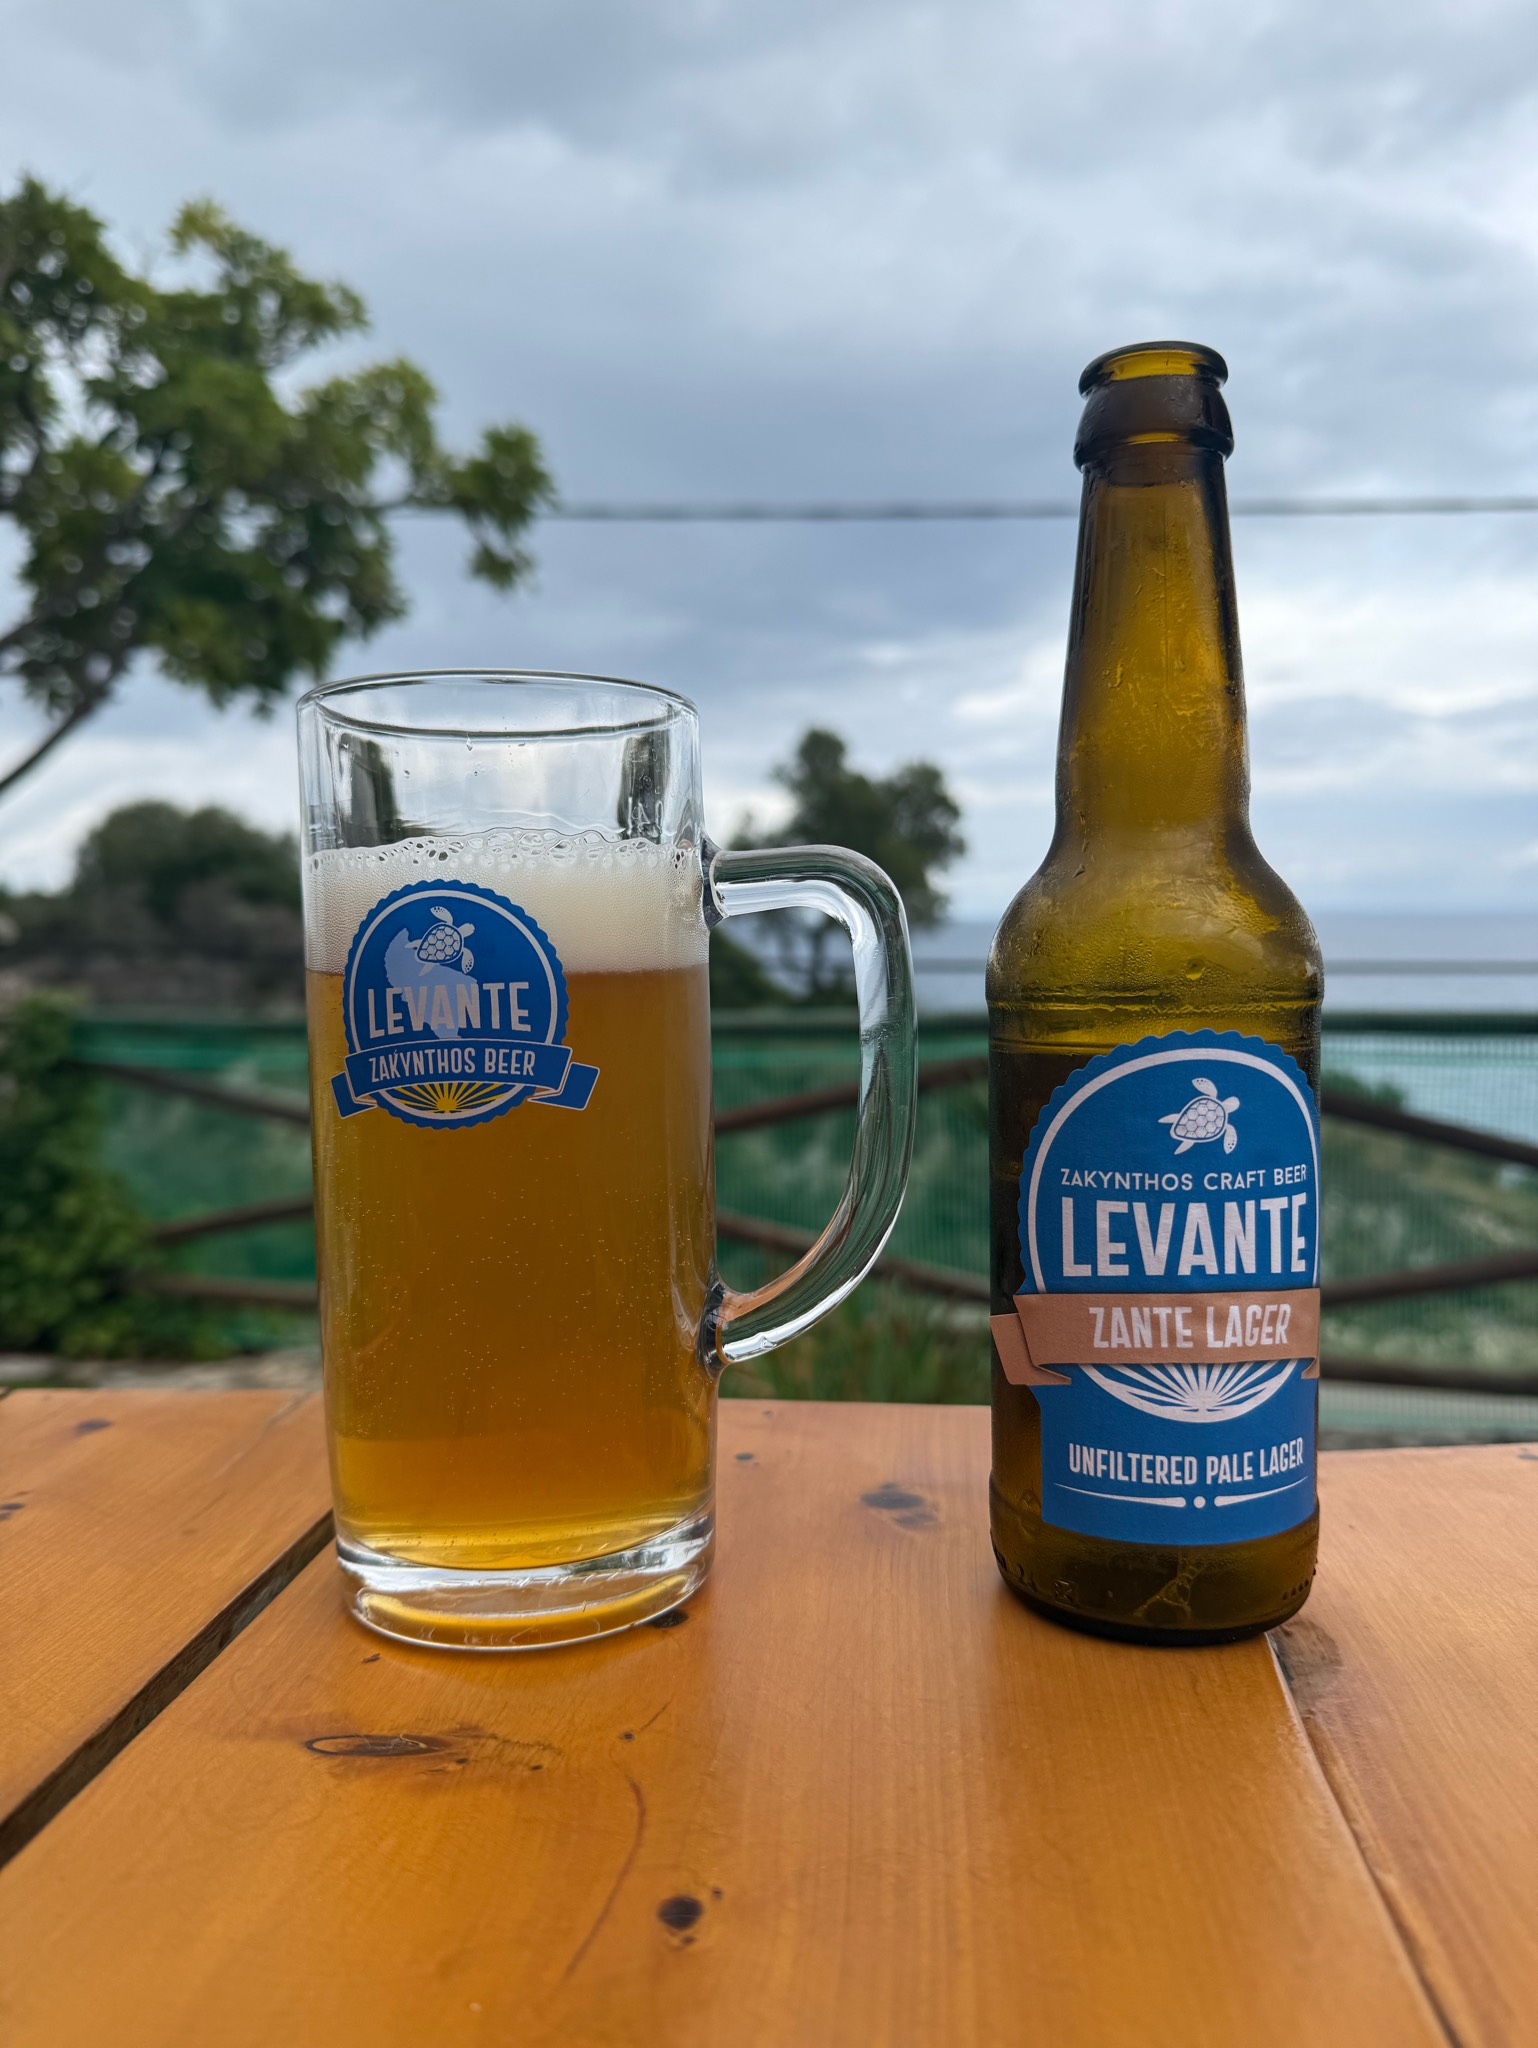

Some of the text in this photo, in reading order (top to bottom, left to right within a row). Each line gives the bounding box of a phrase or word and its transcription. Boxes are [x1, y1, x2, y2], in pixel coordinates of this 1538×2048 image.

[367, 981, 531, 1039] LEVANTE
[368, 1047, 536, 1083] ZAKYNTHOS BEER
[1060, 1163, 1307, 1191] ZAKYNTHOS CRAFT BEER
[1061, 1192, 1307, 1277] LEVANTE
[1088, 1303, 1291, 1348] ZANTE LAGER
[1068, 1437, 1304, 1485] UNFILTERED PALE LAGER
